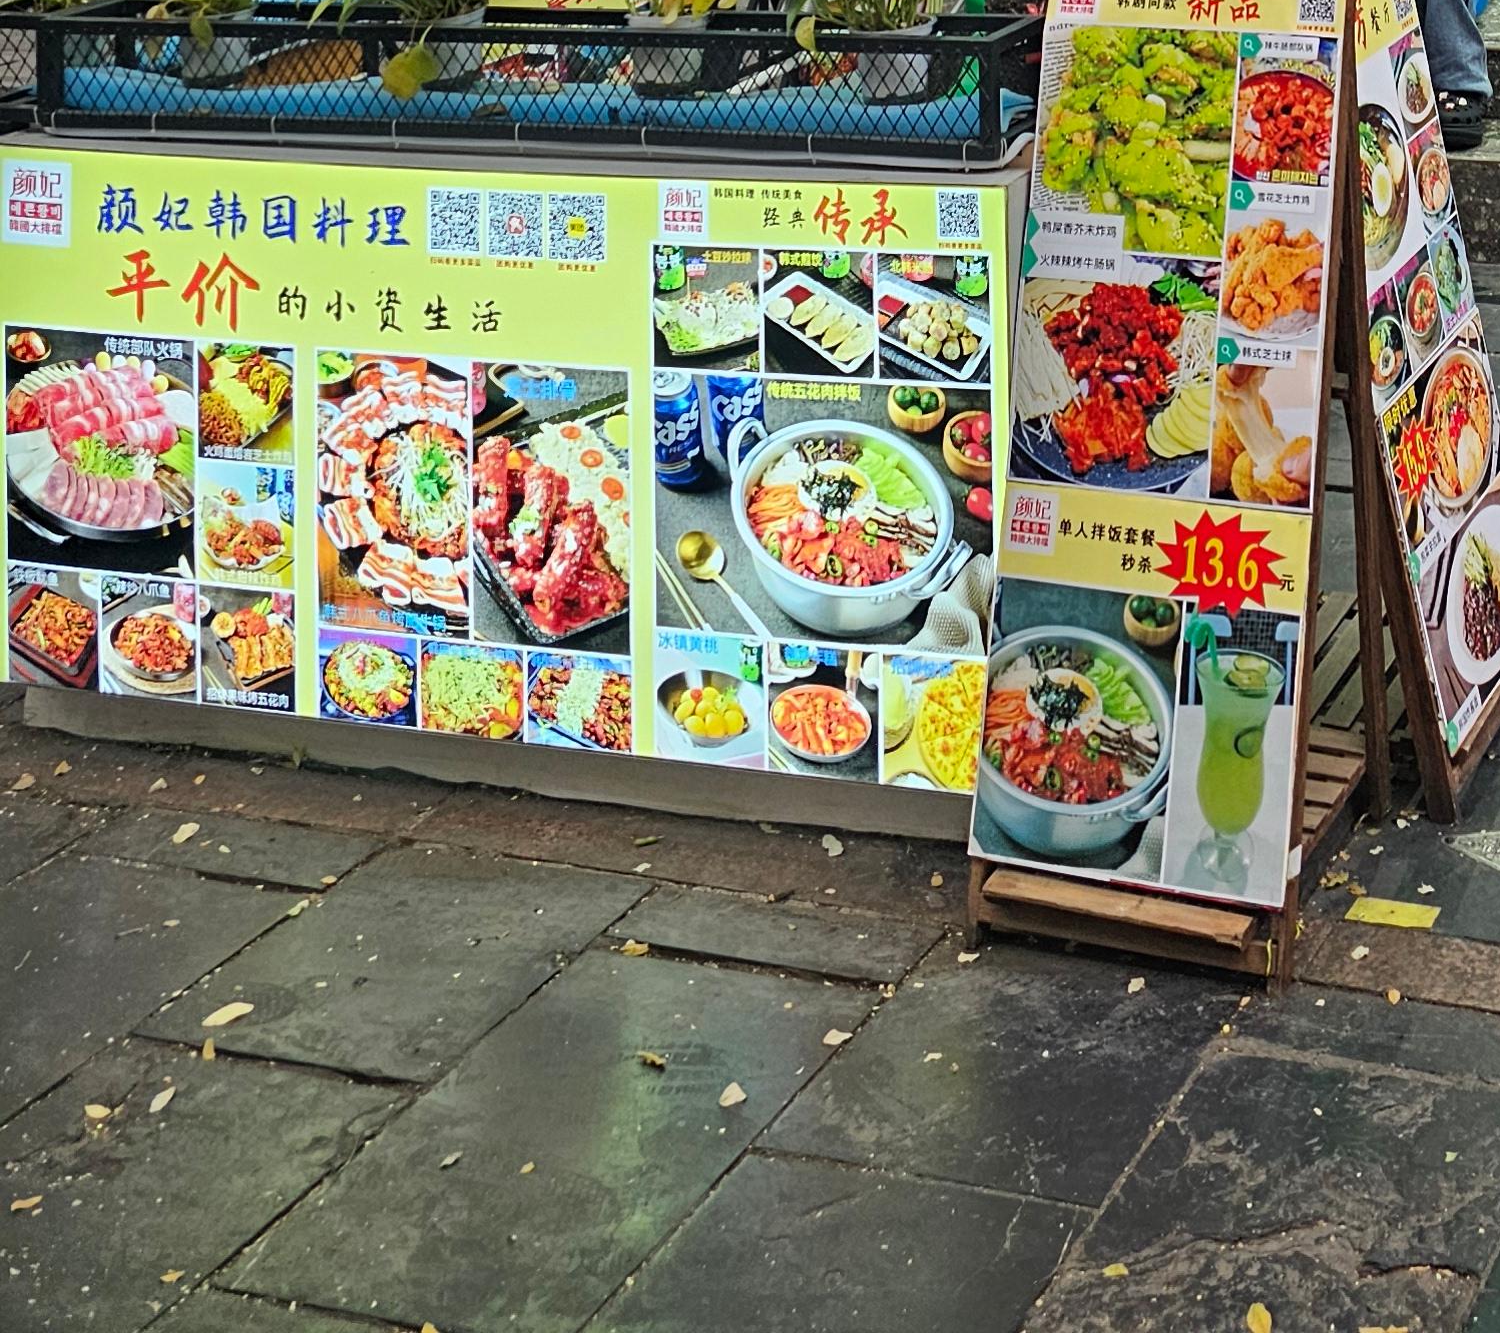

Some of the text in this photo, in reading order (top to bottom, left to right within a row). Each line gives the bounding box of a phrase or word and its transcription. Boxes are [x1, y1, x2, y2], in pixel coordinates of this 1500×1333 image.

[10, 166, 63, 199] 颜妃
[713, 186, 755, 200] 韩国料理
[97, 183, 411, 247] 颜妃韩国料理
[813, 188, 909, 246] 传承
[1041, 219, 1117, 239] 鸭屎香芥末炸鸡
[1039, 252, 1116, 273] 火辣辣烤牛肠锅
[106, 249, 503, 333] 平价 的小资生活
[103, 336, 184, 360] 传统部队火锅
[1013, 495, 1051, 521] 颜妃
[1058, 518, 1156, 548] 单人拌饭套餐
[1120, 535, 1295, 593] 秒杀 13.6 元
[657, 632, 720, 655] 冰镇黄桃
